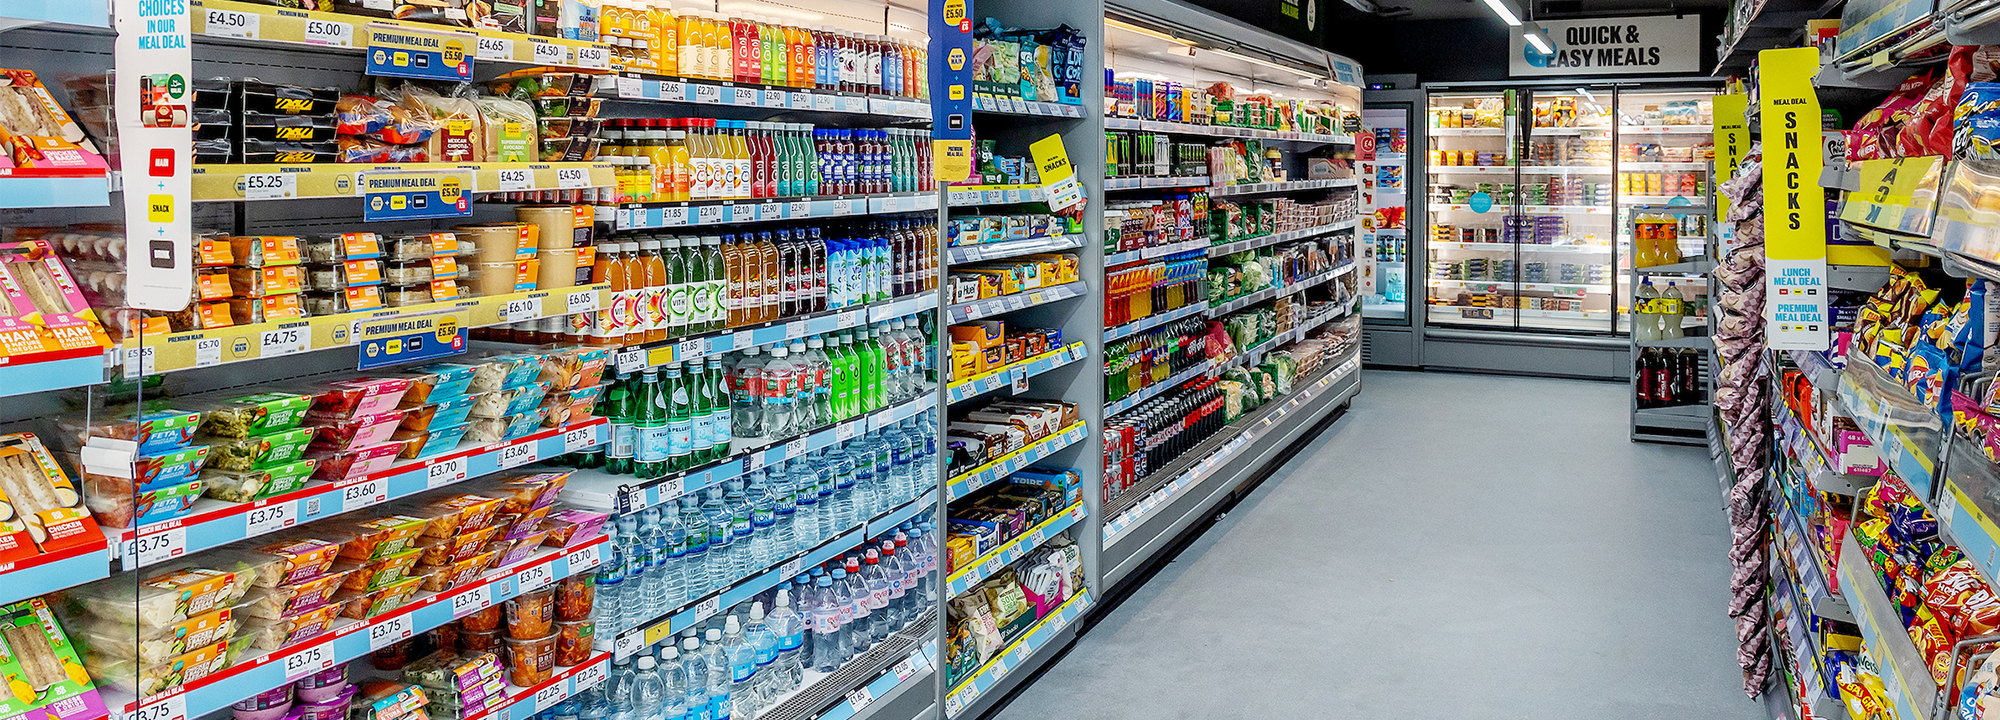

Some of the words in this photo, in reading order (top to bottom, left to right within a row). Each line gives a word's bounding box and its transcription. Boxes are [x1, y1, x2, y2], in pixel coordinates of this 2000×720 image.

[139, 0, 185, 17] CHOICES
[946, 9, 963, 18] £5.50
[208, 12, 245, 27] £4.50
[147, 19, 156, 33] IN
[158, 19, 175, 33] OUR
[308, 22, 340, 36] £5.00
[374, 33, 404, 44] PREMIUM
[405, 36, 422, 46] MEAL
[424, 38, 439, 48] DEAL
[1567, 26, 1621, 45] QUICK
[1626, 25, 1639, 43] &
[138, 36, 160, 50] MEAL
[163, 35, 186, 49] DEAL
[479, 37, 504, 51] £4.65
[536, 43, 558, 56] £4.50
[580, 48, 600, 60] £4.50
[444, 51, 462, 61] £5.50
[1597, 46, 1660, 66] MEALS
[661, 83, 678, 92] £2.65
[698, 86, 714, 95] £2.70
[736, 89, 751, 98] £2.95
[766, 92, 780, 100] £2.90
[793, 94, 806, 103] £2.90
[1044, 158, 1066, 173] SNACKS
[1785, 112, 1800, 230] SNACKS
[501, 171, 525, 182] £4.25
[559, 170, 581, 181] £4.50
[248, 175, 282, 189] £5.25
[370, 180, 400, 188] PREMIUM
[402, 179, 419, 187] MEAL
[420, 178, 436, 187] DEAL
[442, 188, 459, 197] £5.50
[152, 204, 170, 213] SNACK
[664, 209, 681, 218] £1.85
[700, 207, 716, 216] £2.10
[733, 206, 750, 215] £2.10
[762, 205, 776, 213] £2.90
[1782, 268, 1810, 276] LUNCH
[1774, 277, 1798, 286] MEAL
[1800, 277, 1821, 286] DEAL
[963, 284, 976, 295] Huel
[569, 293, 590, 304] £6.05
[509, 301, 532, 312] £6.10
[1778, 304, 1817, 312] PREMIUM
[1775, 313, 1800, 321] MEAL
[1802, 313, 1822, 322] DEAL
[52, 326, 90, 338] HAM
[366, 324, 397, 335] PREMIUM
[398, 321, 415, 331] MEAL
[416, 319, 432, 329] DEAL
[438, 326, 456, 336] £5.50
[0, 330, 38, 343] HAM
[167, 335, 188, 343] PREMIUM
[264, 331, 297, 346] £4.75
[7, 344, 43, 353] CHEDDAR
[61, 340, 96, 348] CHEDDAR
[198, 340, 219, 350] £5.70
[681, 341, 698, 352] £1.85
[620, 353, 638, 364] £1.85
[151, 430, 178, 440] FETA,
[567, 430, 587, 443] £3.75
[504, 445, 528, 459] £3.60
[787, 441, 801, 452] £1.95
[161, 464, 187, 474] FETA,
[430, 462, 456, 477] £3.70
[346, 483, 375, 500] £3.60
[659, 481, 677, 494] £1.75
[154, 498, 181, 509] FETA,
[250, 507, 284, 525] £3.75
[48, 520, 82, 533] CHICKEN
[137, 525, 154, 536] LUNCH
[154, 522, 168, 532] MEAL
[169, 519, 182, 529] DEAL
[128, 534, 169, 556] £3.75
[570, 550, 590, 565] £3.70
[781, 562, 795, 574] £1.80
[520, 567, 543, 583] £3.75
[455, 591, 480, 608] £3.75
[697, 601, 713, 614] £1.50
[372, 620, 401, 638] £3.75
[256, 655, 269, 664] MAIN
[288, 649, 321, 670] £3.75
[895, 662, 909, 672] £2.05
[577, 667, 598, 683] £2.25
[139, 694, 157, 705] LUNCH
[157, 689, 172, 700] MEAL
[172, 685, 185, 695] DEAL
[538, 685, 560, 703] £2.25
[851, 692, 865, 704] £1.65
[53, 695, 82, 707] CHEESE
[62, 701, 85, 711] ONION
